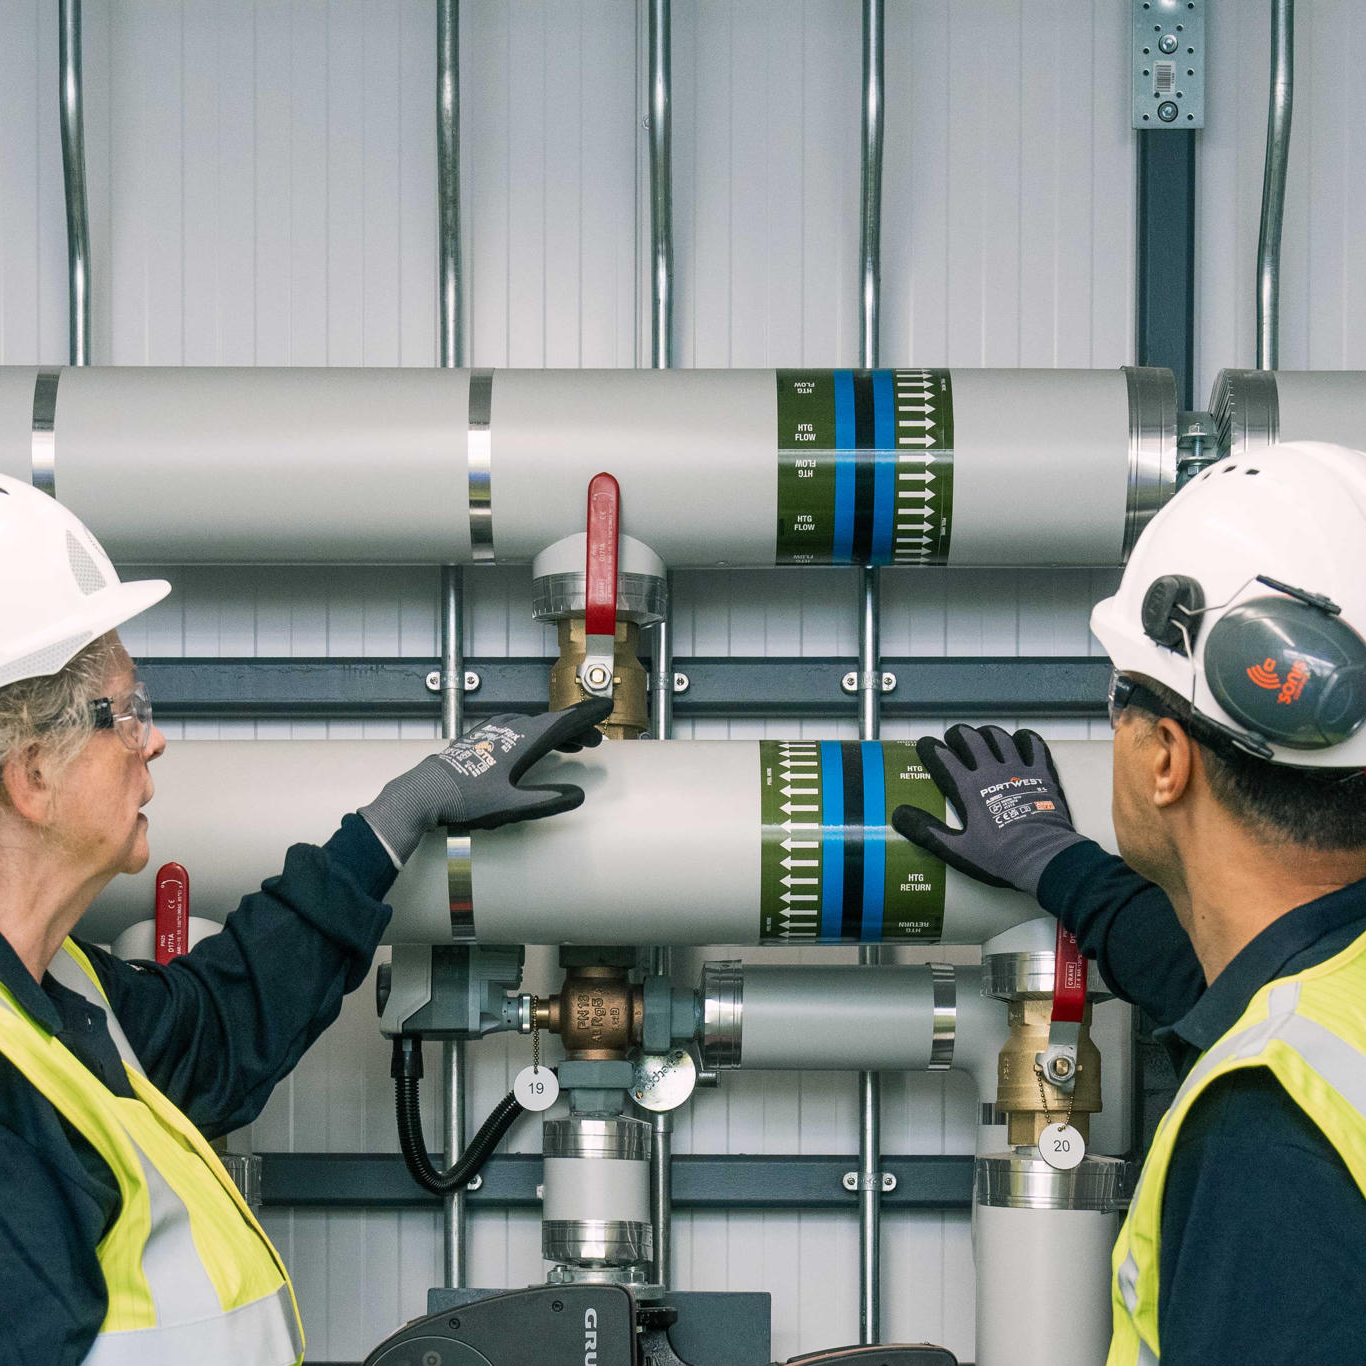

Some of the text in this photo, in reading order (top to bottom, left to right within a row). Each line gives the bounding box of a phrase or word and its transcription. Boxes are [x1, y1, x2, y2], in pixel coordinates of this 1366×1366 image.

[797, 423, 813, 431] HTG
[795, 433, 816, 441] FLOW
[795, 459, 816, 467] FLOW
[797, 515, 813, 523] HTG
[794, 523, 815, 531] FLOW
[980, 778, 1043, 798] PORTWEST
[908, 873, 924, 881] HTG
[900, 883, 932, 891] RETURN
[528, 1082, 545, 1094] 19
[1053, 1139, 1071, 1152] 20
